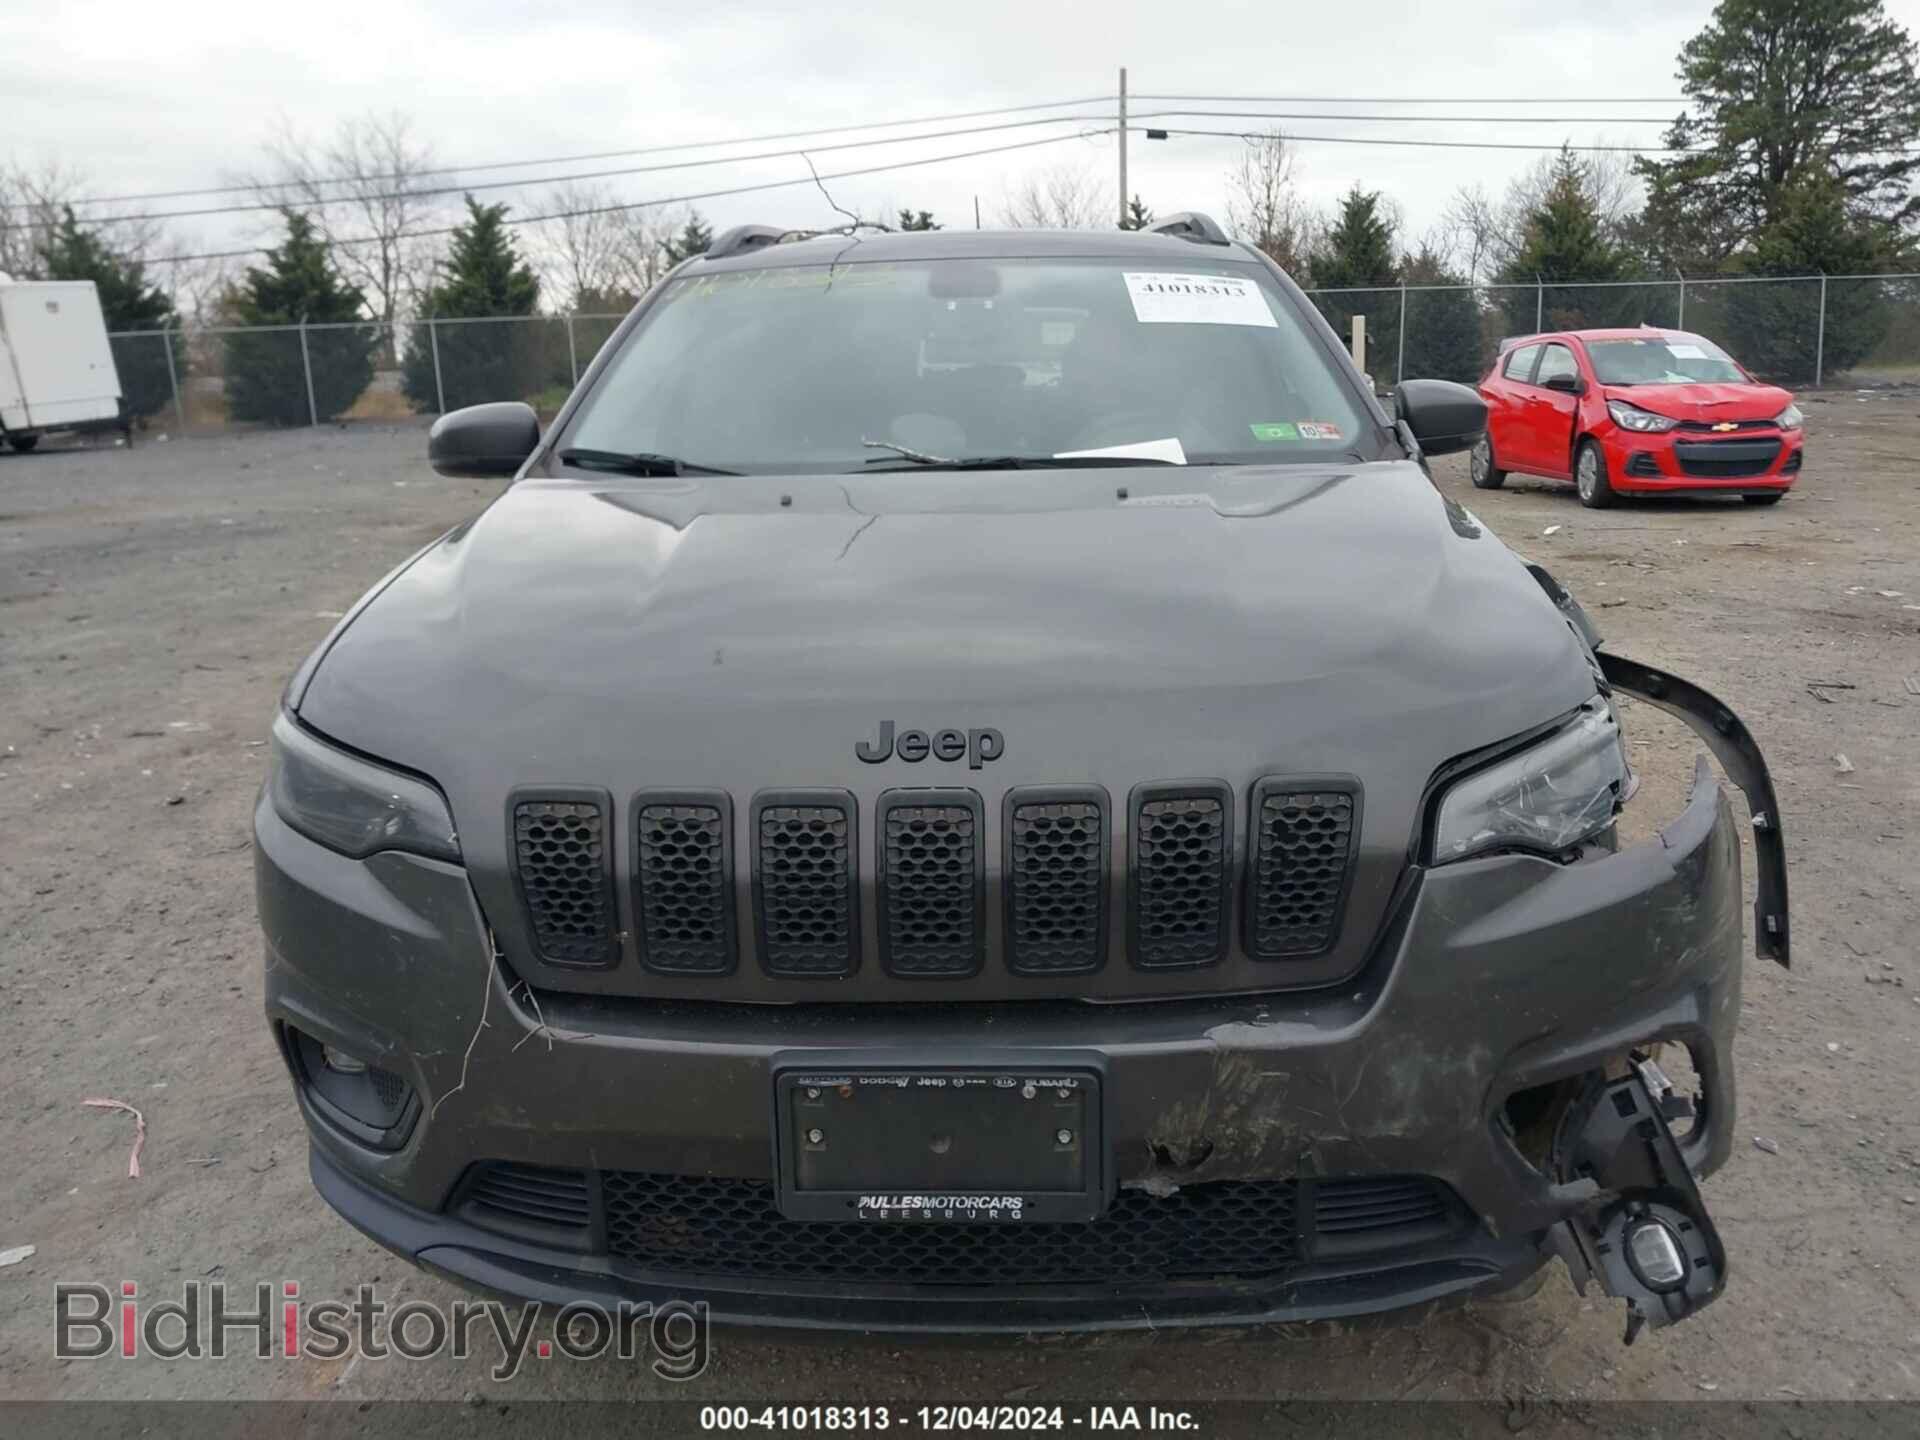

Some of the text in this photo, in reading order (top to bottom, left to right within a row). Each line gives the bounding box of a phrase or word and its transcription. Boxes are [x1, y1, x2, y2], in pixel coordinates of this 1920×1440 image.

[1141, 283, 1247, 297] 41018313
[855, 720, 1005, 770] Jeep
[917, 1077, 946, 1088] Jeep
